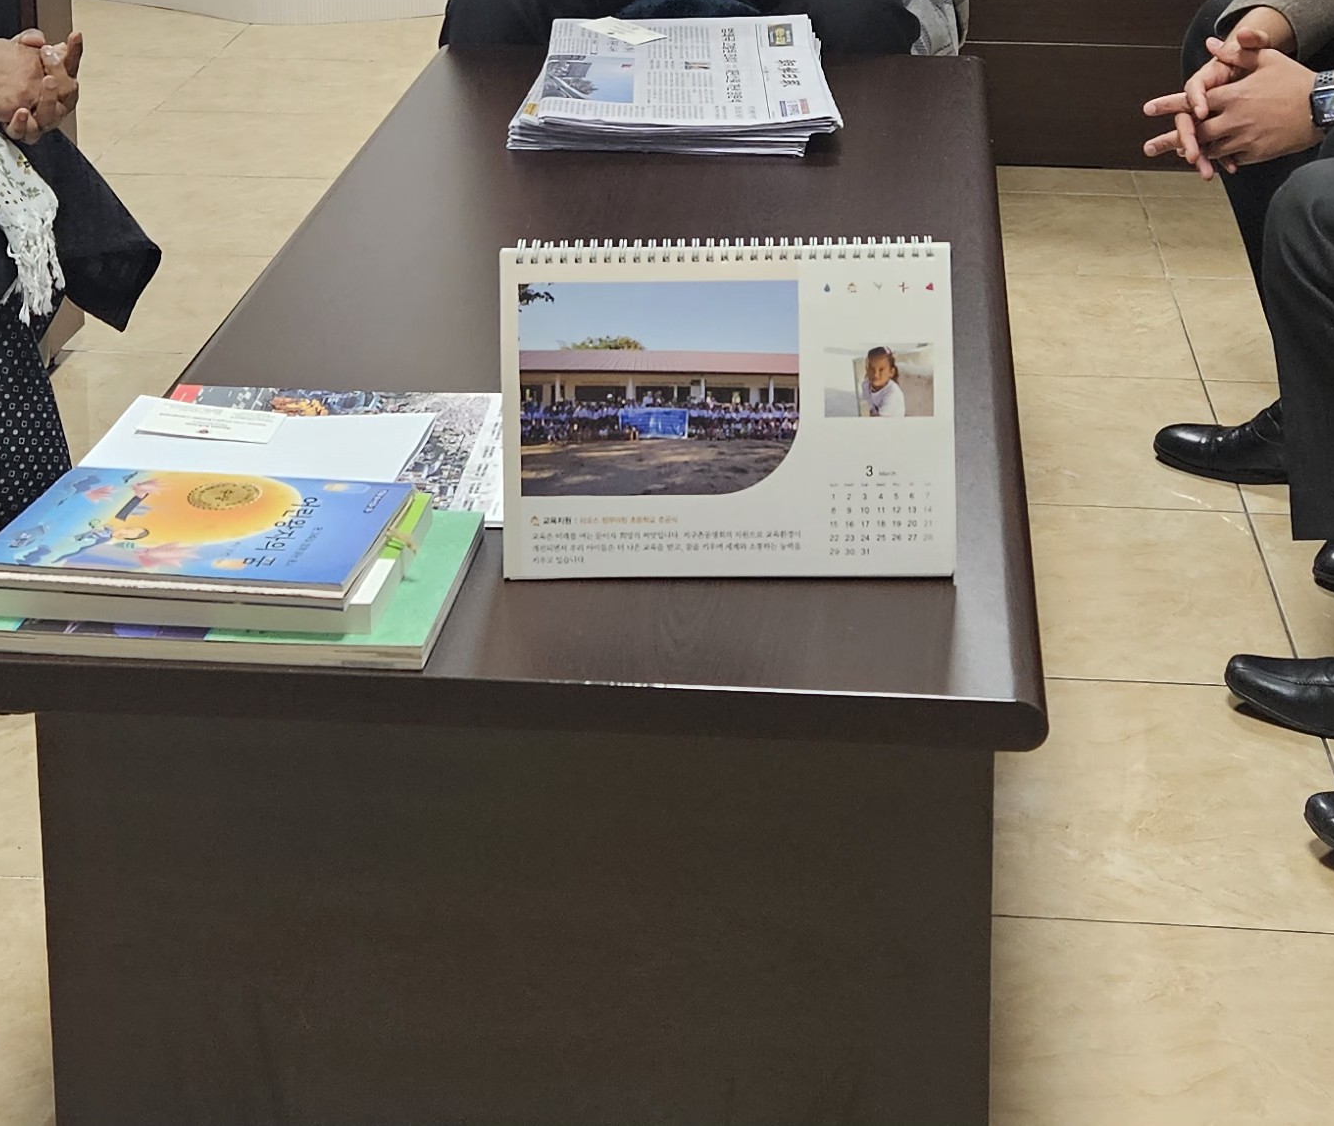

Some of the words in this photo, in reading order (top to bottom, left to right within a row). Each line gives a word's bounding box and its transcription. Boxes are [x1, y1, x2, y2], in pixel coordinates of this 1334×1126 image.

[865, 465, 874, 477] 3
[255, 497, 320, 551] 어린왕자의
[543, 516, 572, 525] 교육지원
[830, 534, 839, 542] 22
[243, 556, 276, 567] 꿈
